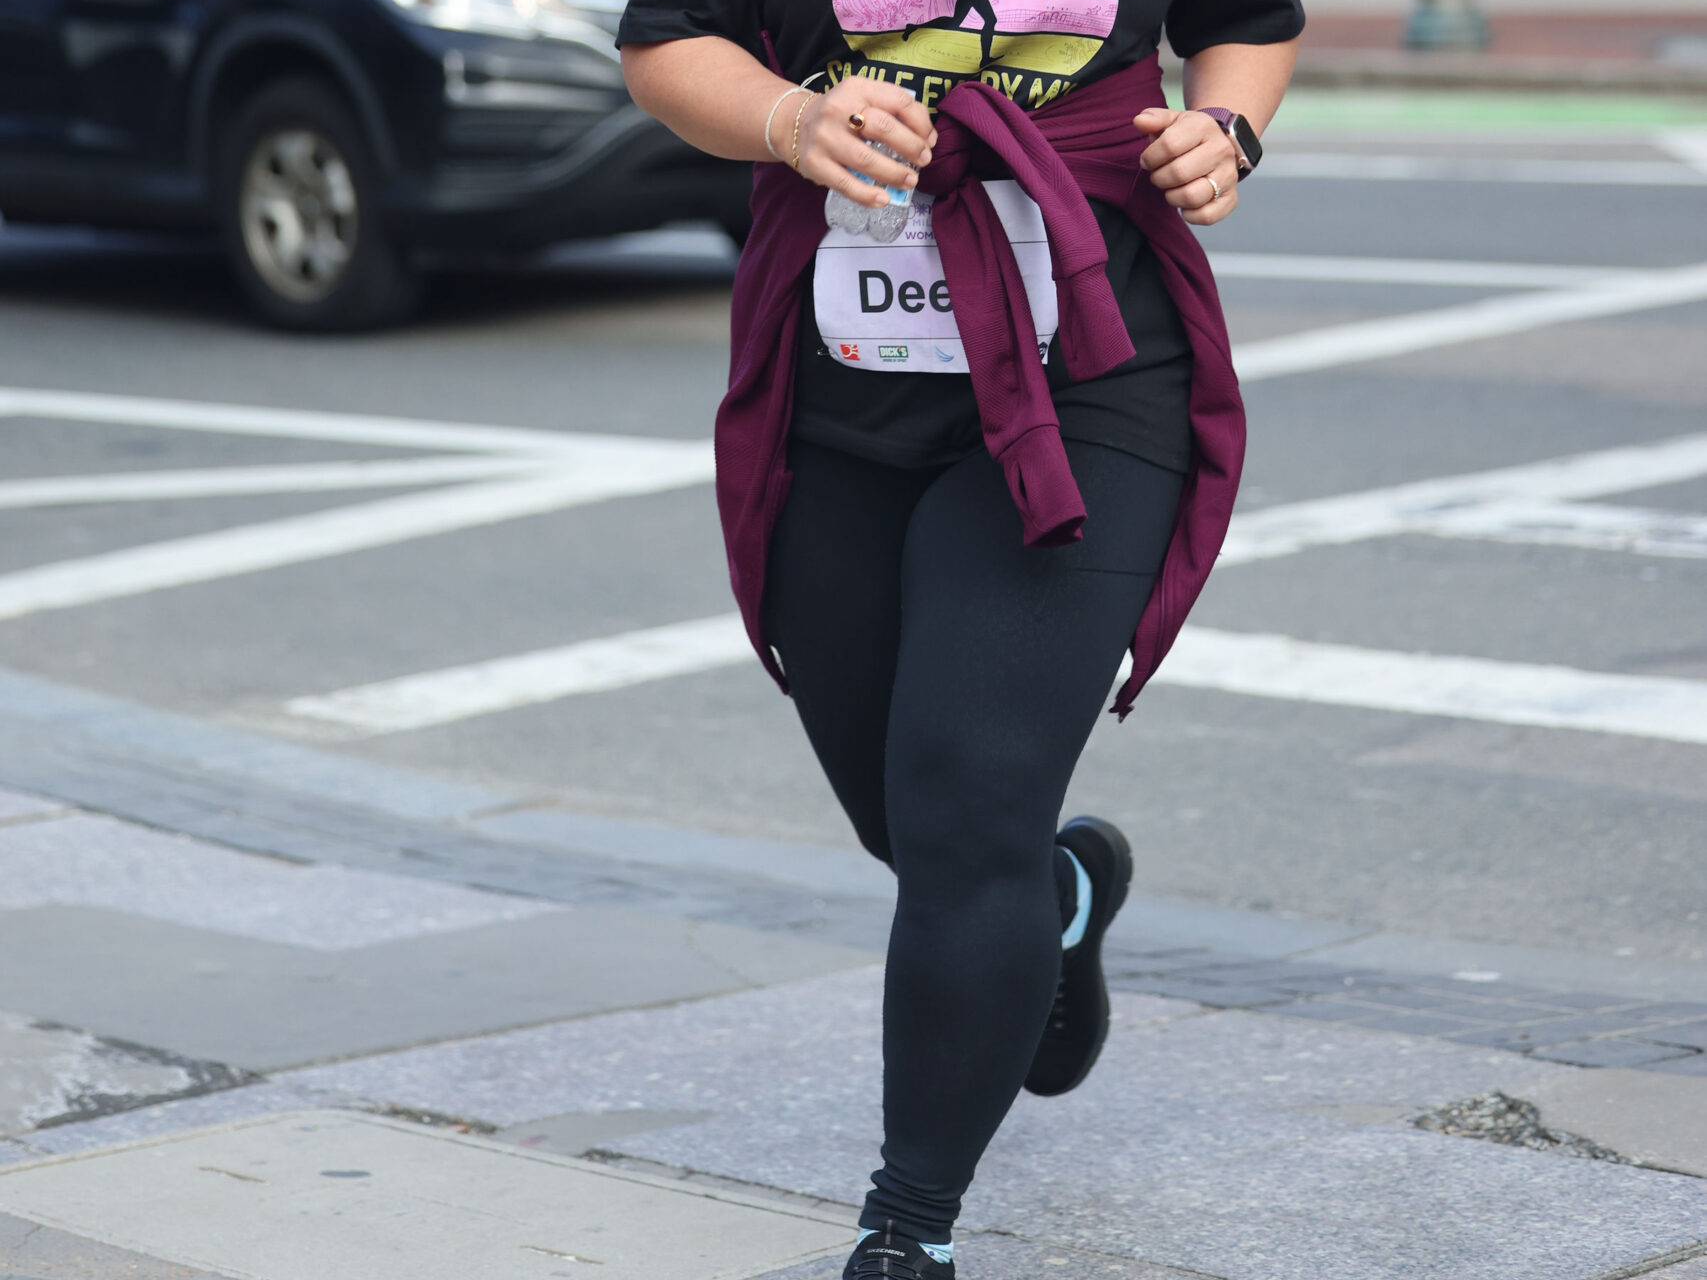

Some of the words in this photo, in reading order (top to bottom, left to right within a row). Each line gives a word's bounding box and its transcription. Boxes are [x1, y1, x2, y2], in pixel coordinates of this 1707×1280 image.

[905, 231, 934, 240] WOM
[879, 346, 908, 357] DICK'S
[867, 1248, 906, 1257] SKECHERS
